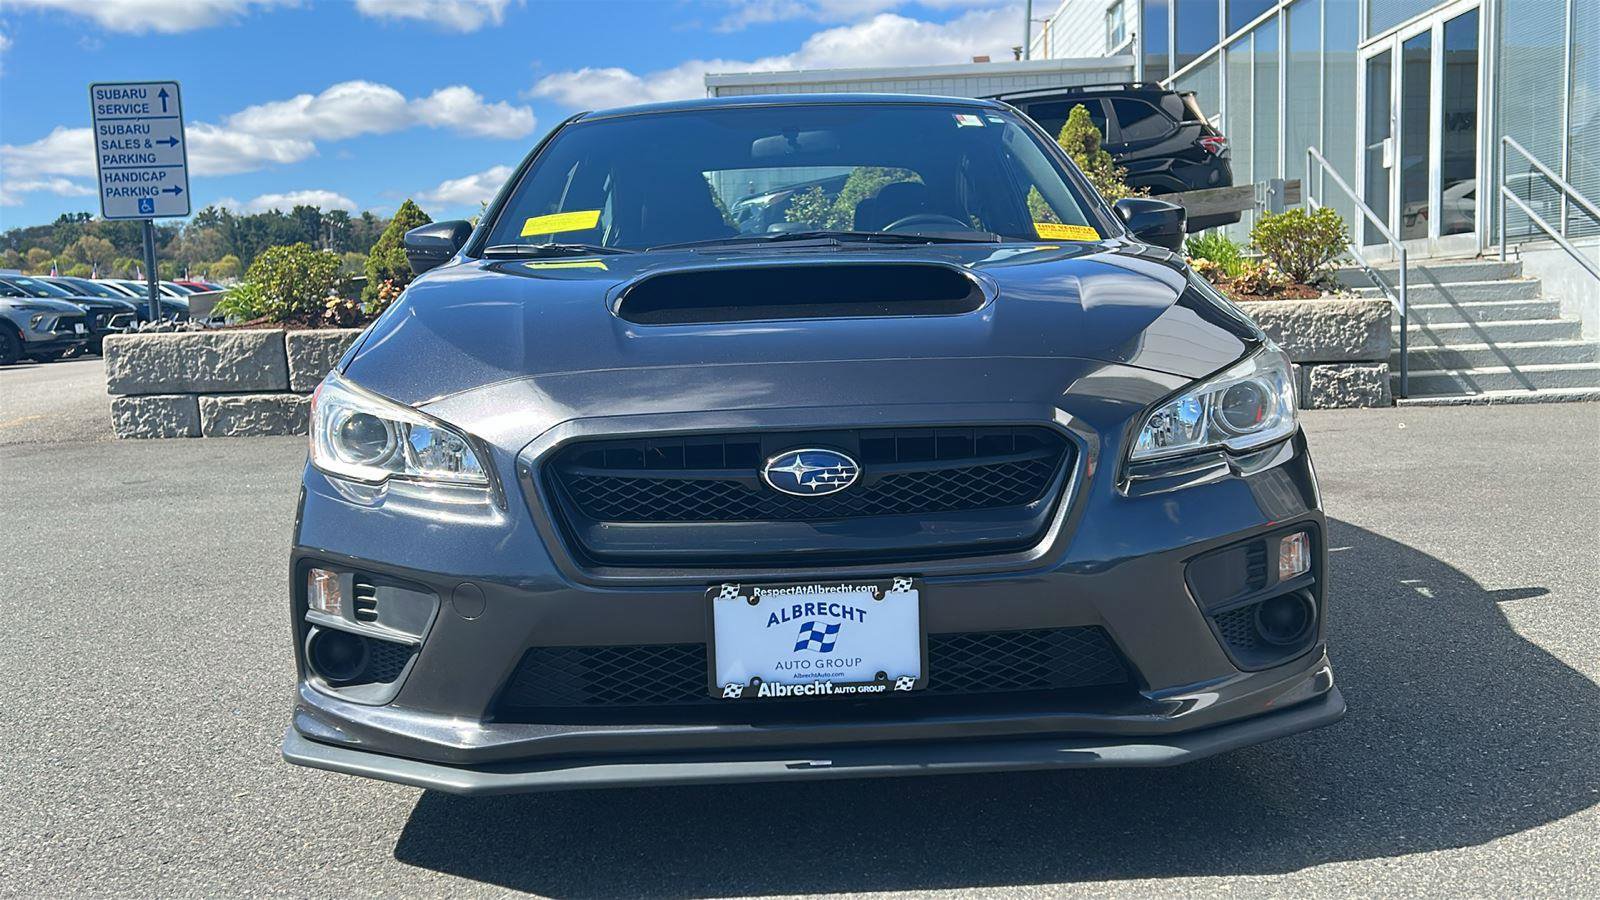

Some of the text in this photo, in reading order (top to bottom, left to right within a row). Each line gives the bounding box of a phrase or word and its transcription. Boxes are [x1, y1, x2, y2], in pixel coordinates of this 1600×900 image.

[96, 88, 147, 100] SUBARU
[98, 103, 150, 115] SERVICE
[100, 124, 150, 136] SUBARU
[101, 139, 153, 150] SALES &
[103, 153, 157, 165] PARKING
[104, 171, 167, 183] HANDICAP
[106, 186, 160, 198] PARKING
[753, 584, 878, 598] RespectAtAlbrecht.com
[766, 602, 867, 628] ALBRECHT
[775, 658, 862, 670] AUTO GROUP
[793, 671, 845, 679] AlbrechtAuto.com
[757, 680, 833, 698] Albrecht
[857, 685, 886, 693] GROUP
